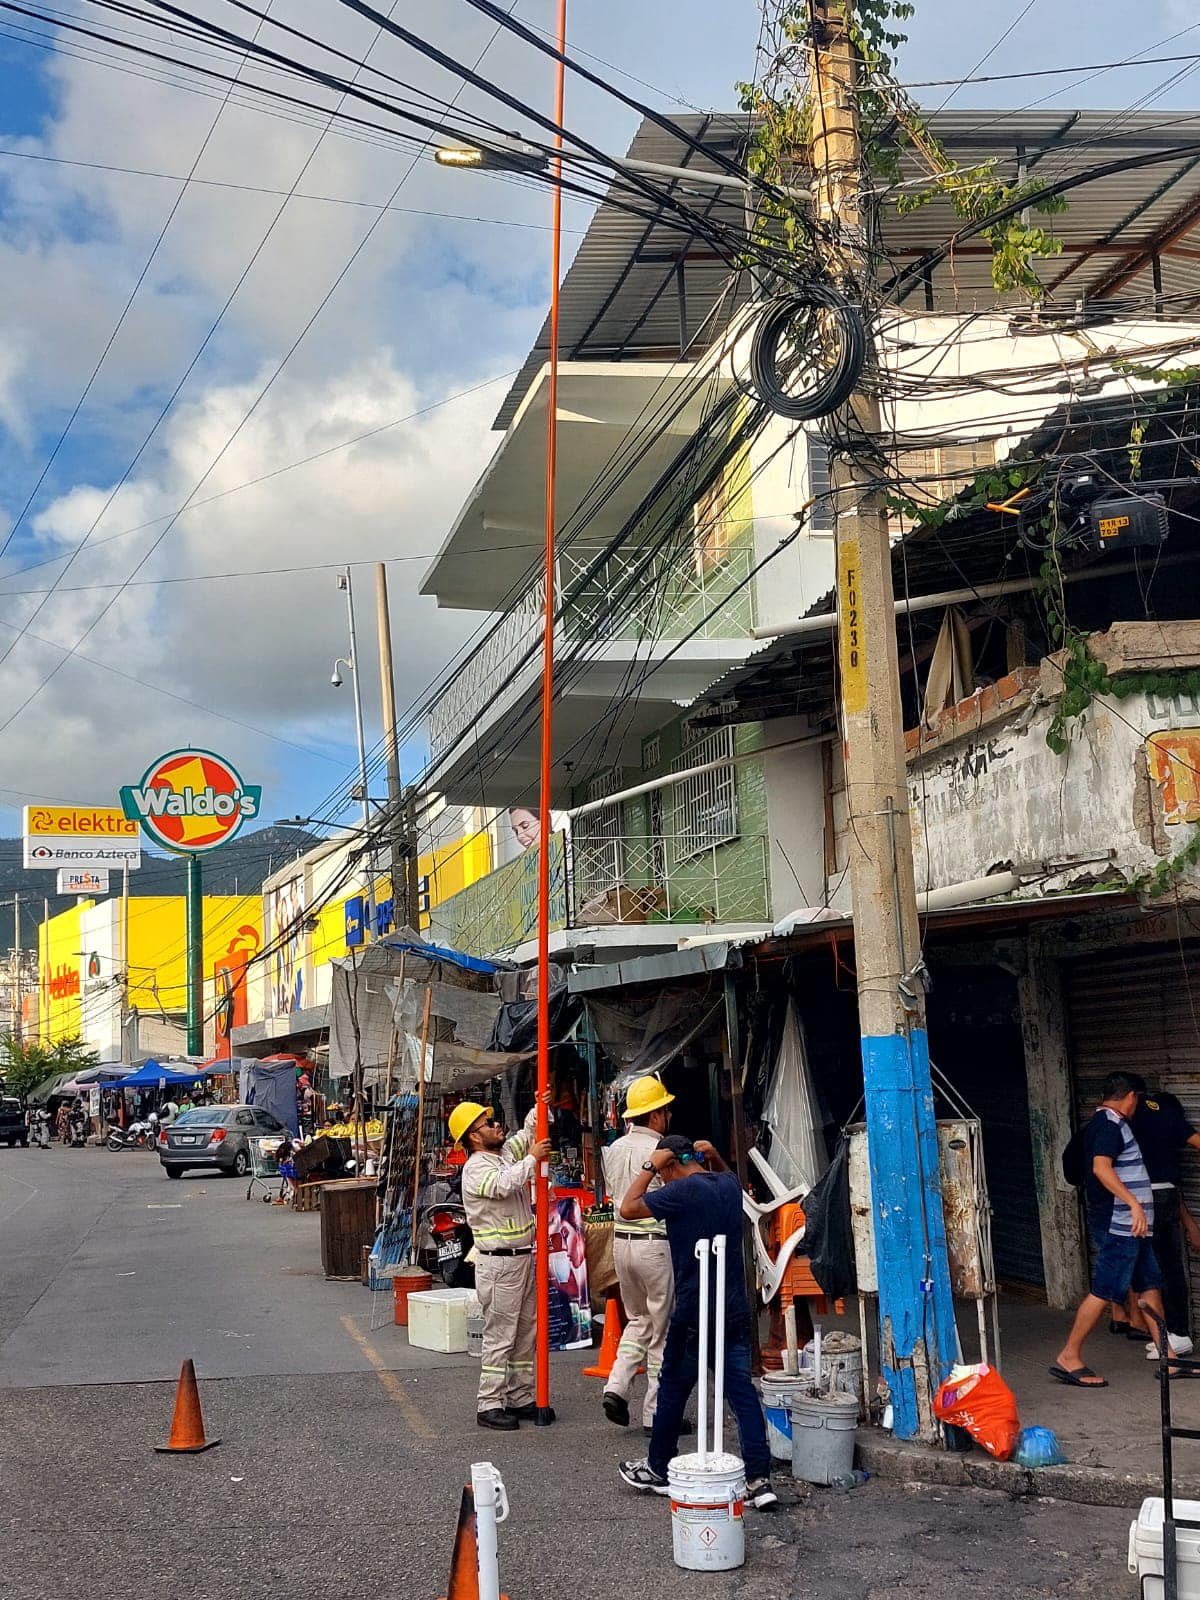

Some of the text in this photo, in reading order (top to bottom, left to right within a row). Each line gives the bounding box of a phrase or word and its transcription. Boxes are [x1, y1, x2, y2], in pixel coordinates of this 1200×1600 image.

[847, 570, 859, 667] F0230
[131, 787, 256, 816] Waldo's
[57, 812, 137, 833] elektra
[56, 848, 137, 860] Banco Azteca
